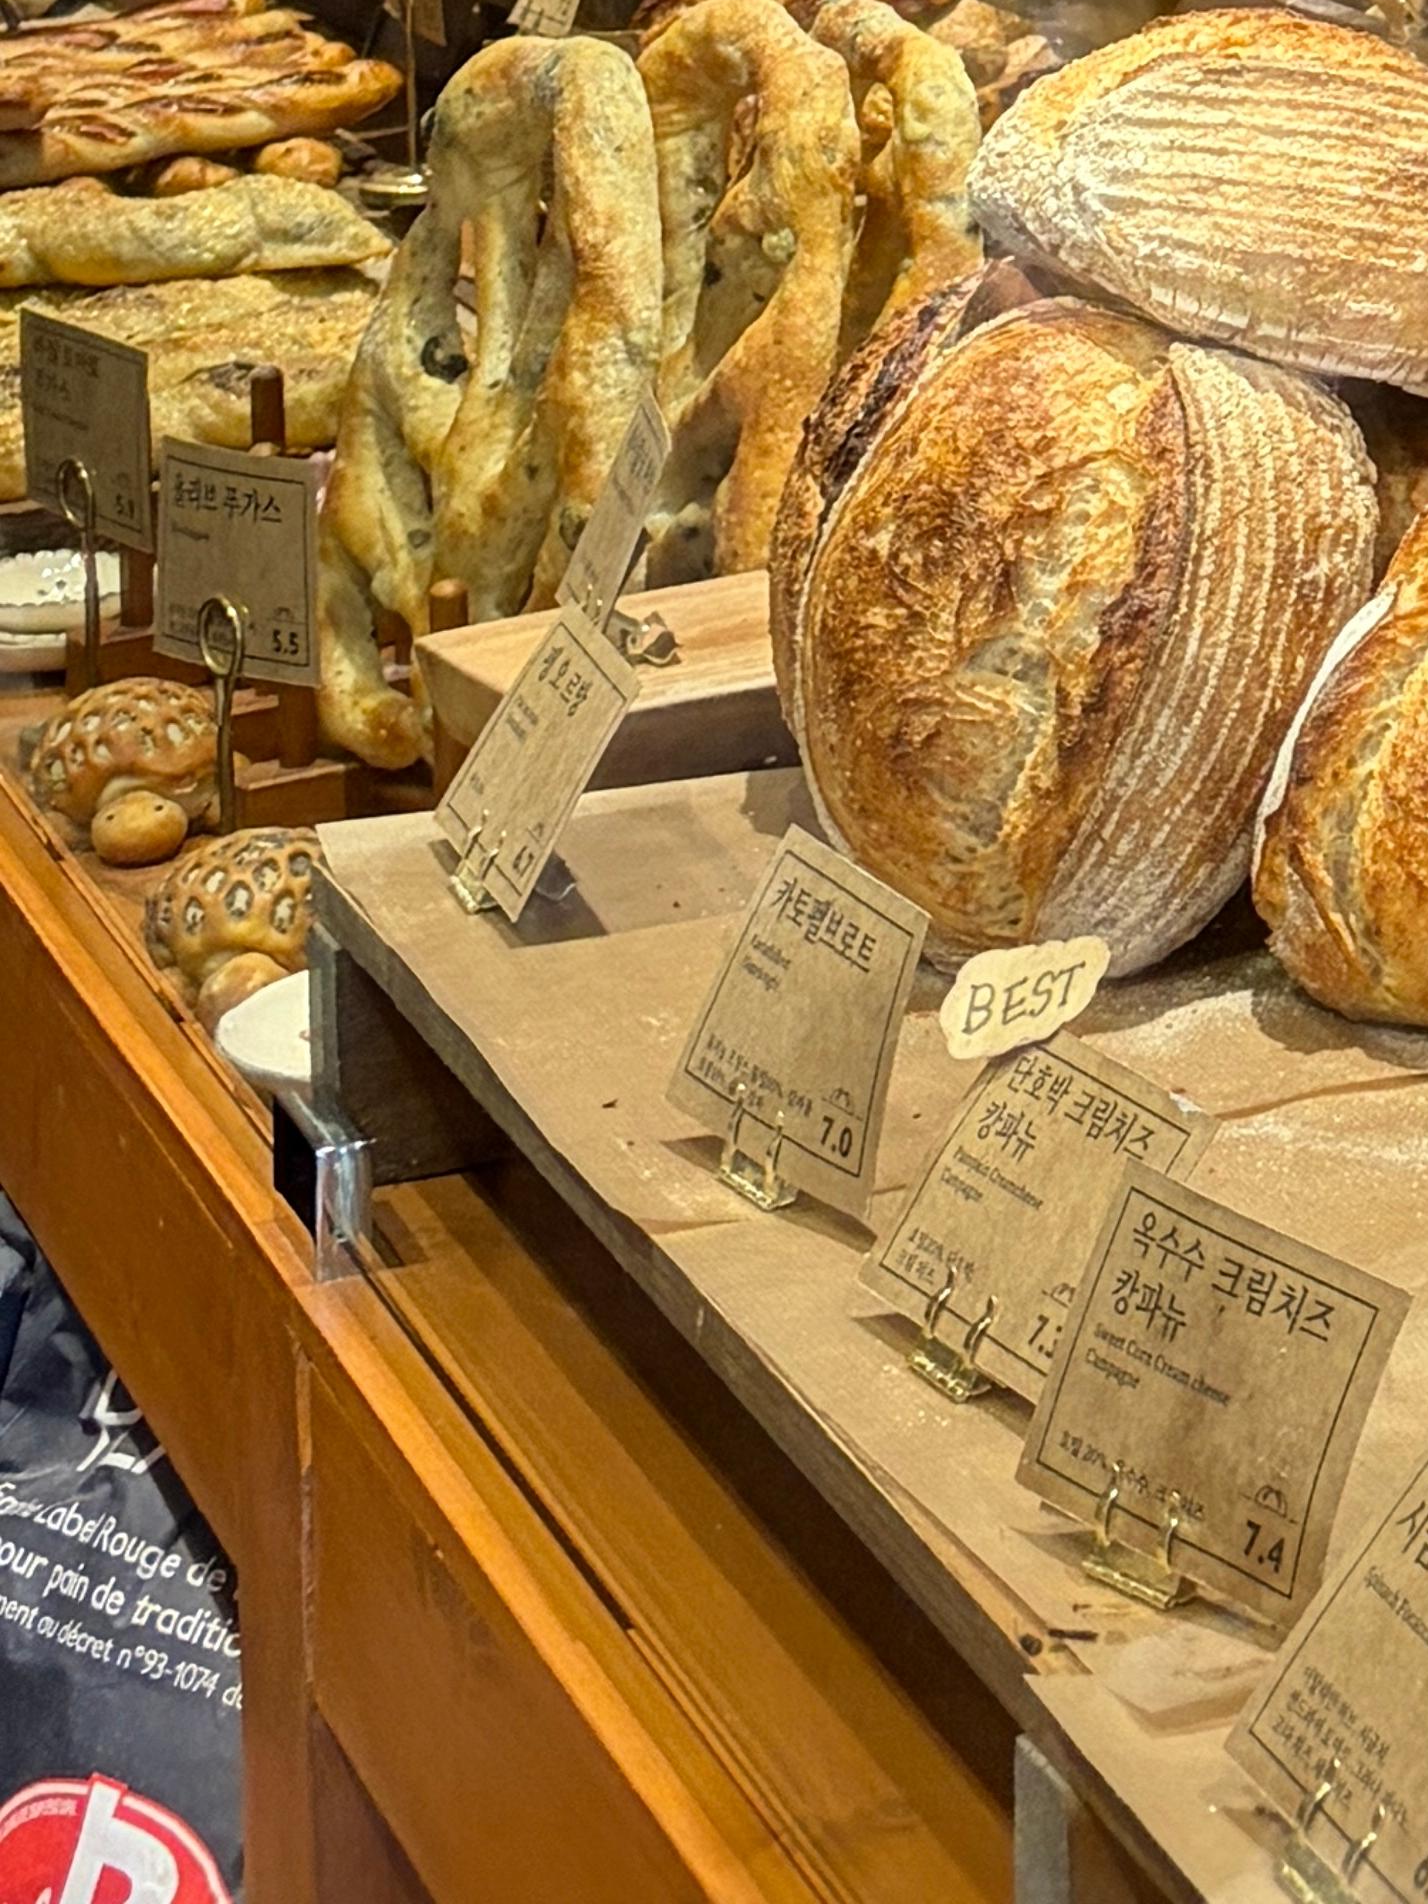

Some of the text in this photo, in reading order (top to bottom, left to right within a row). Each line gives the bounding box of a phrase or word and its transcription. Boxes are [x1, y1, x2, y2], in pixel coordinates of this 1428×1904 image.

[222, 485, 283, 524] 푸가스
[271, 627, 299, 656] 5.5
[961, 960, 1087, 1035] BEST
[819, 1115, 854, 1158] 7.0
[976, 1100, 1039, 1163] 캉파뉴
[1007, 1055, 1155, 1161] 단호박 크림치즈
[1112, 1268, 1188, 1343] 캉파뉴
[1132, 1211, 1335, 1343] 옥수수 크림치즈
[0, 1539, 49, 1579] our
[42, 1562, 90, 1603] pain
[91, 1576, 126, 1615] de
[102, 1515, 182, 1580] Rouge
[186, 1556, 228, 1591] de
[1243, 1519, 1285, 1573] 7.4
